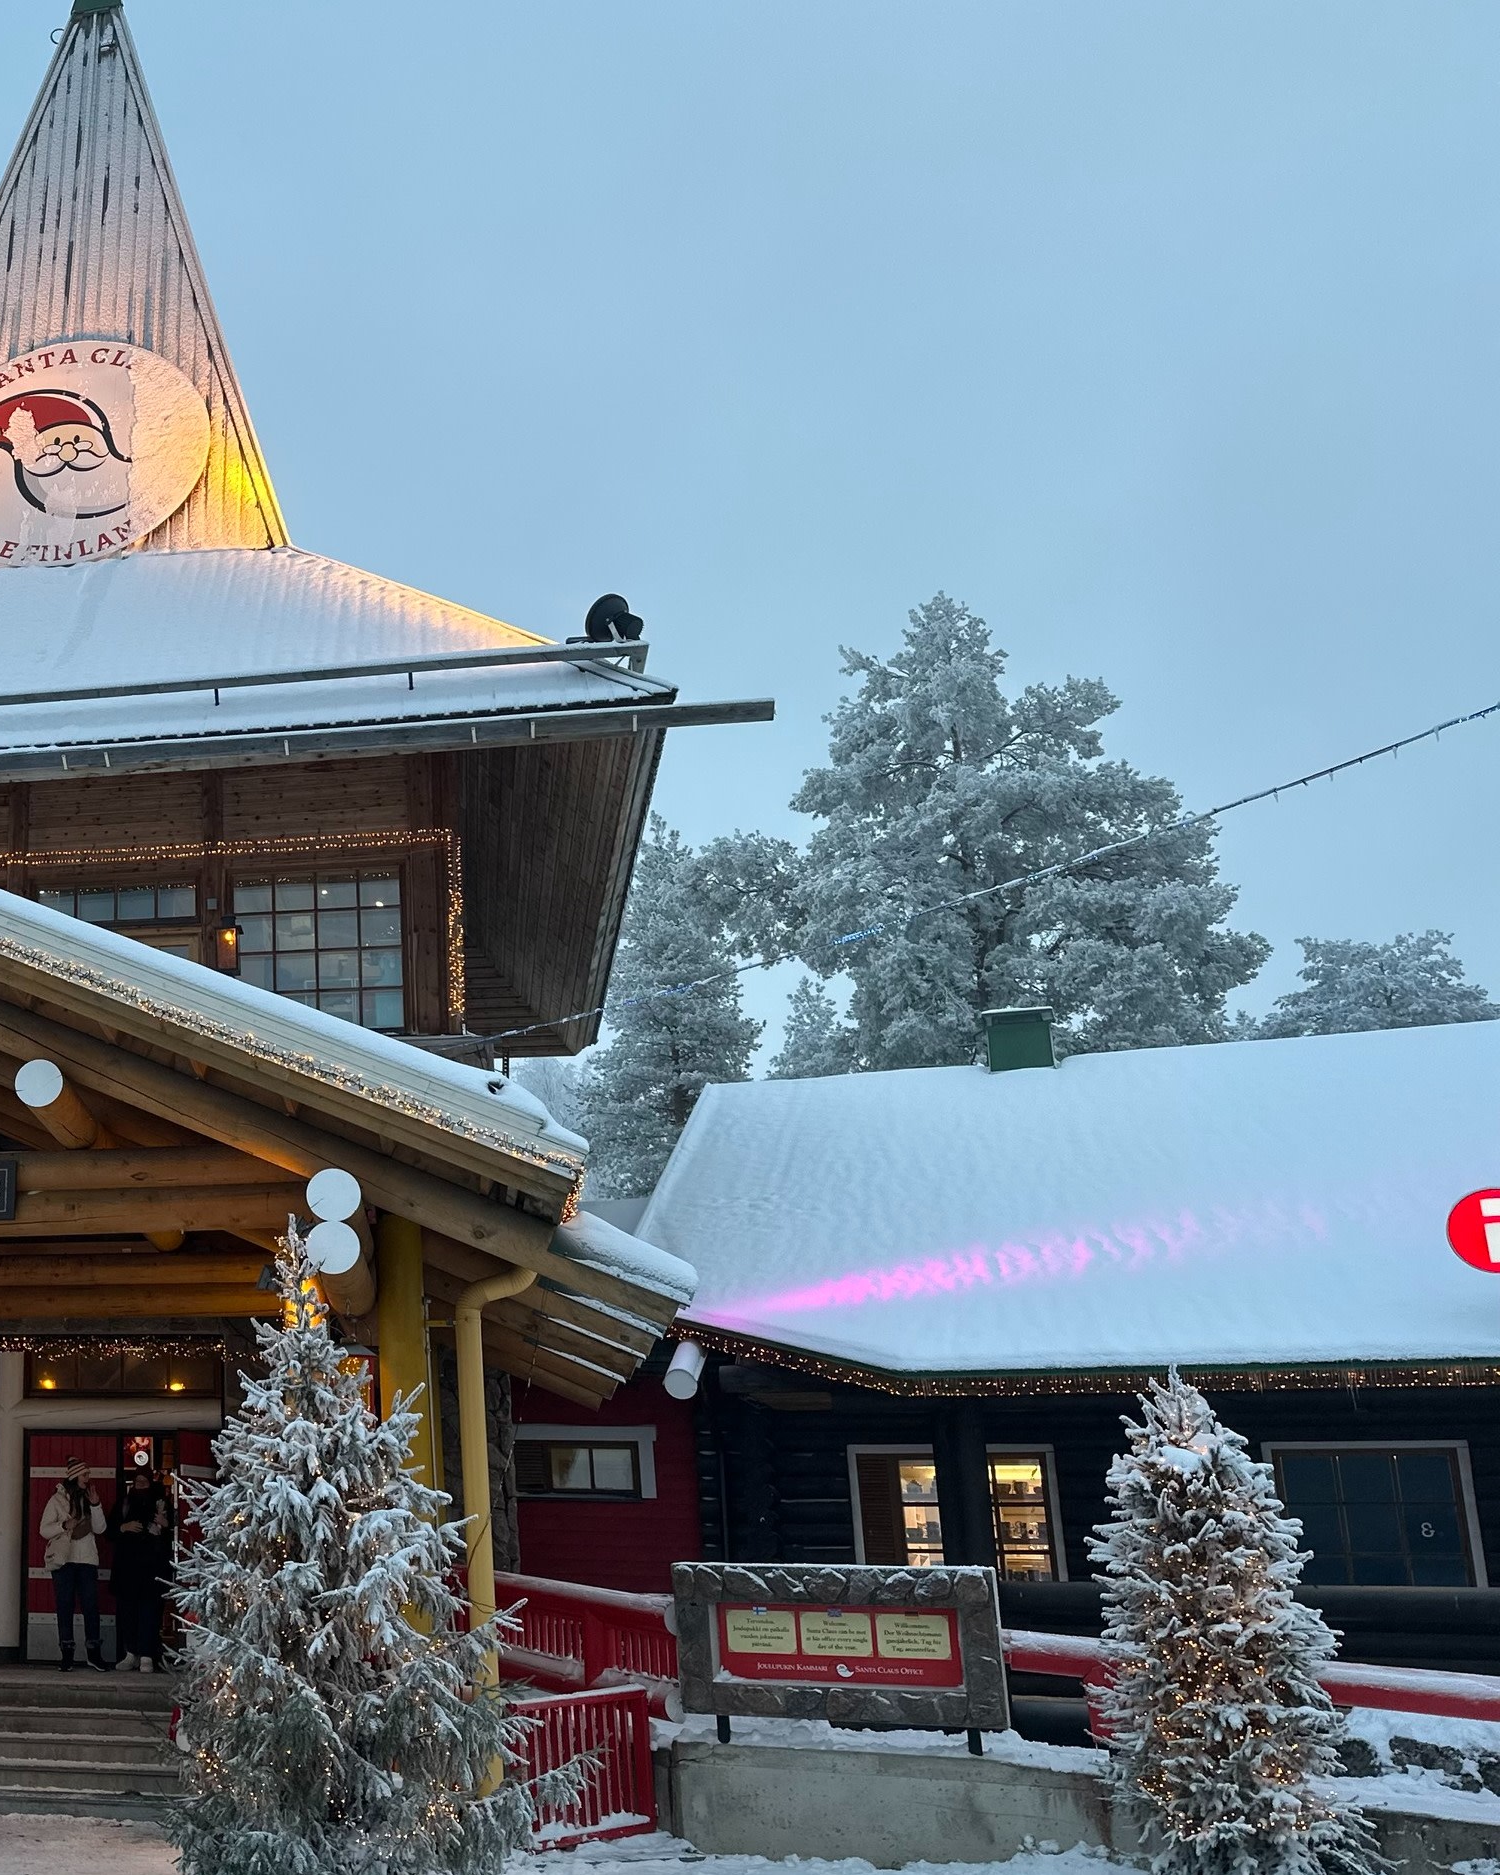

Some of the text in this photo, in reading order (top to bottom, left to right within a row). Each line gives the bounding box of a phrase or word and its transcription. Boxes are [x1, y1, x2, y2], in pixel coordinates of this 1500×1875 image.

[757, 1662, 828, 1672] JOULUPUKIN KAMMARI
[855, 1665, 924, 1675] SANTA CLAUS OFFICE
